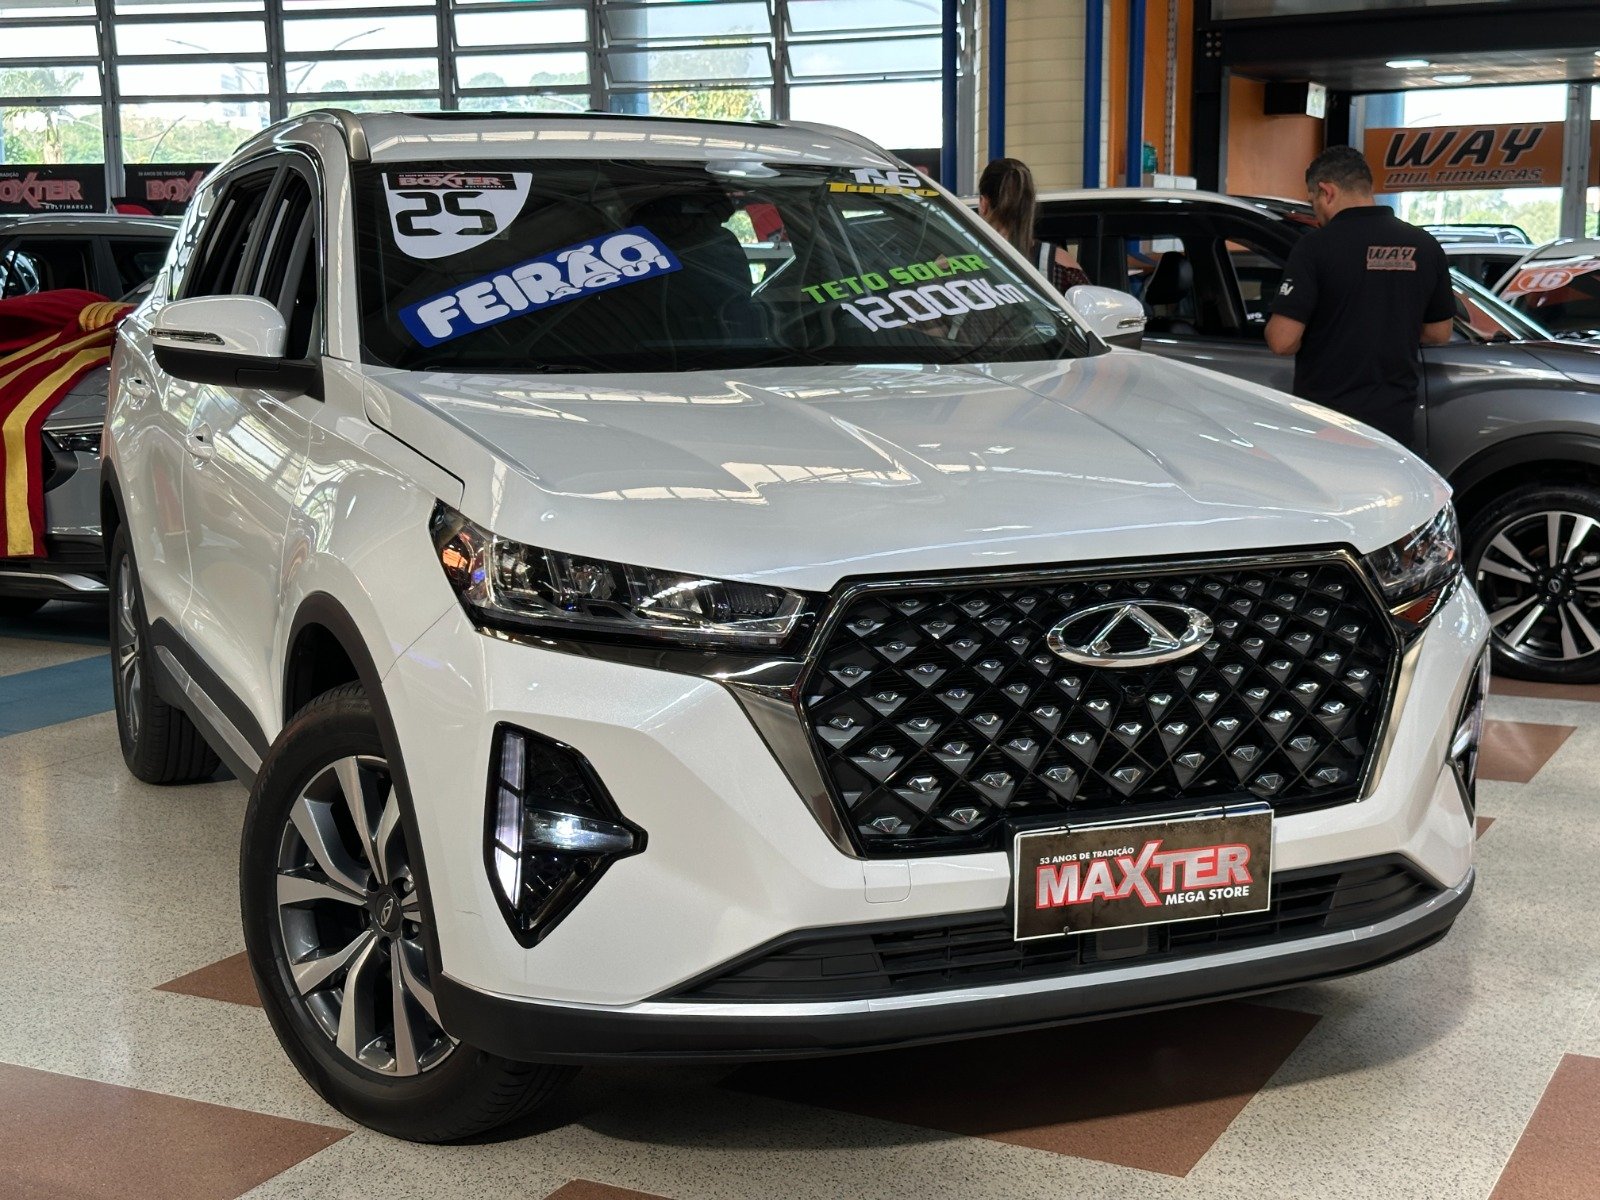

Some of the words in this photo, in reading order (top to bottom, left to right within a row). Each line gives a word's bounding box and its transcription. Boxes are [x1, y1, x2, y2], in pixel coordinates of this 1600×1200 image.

[1384, 125, 1546, 168] WAY
[0, 172, 83, 208] OXTER
[146, 170, 204, 202] BOX
[398, 173, 505, 188] BOXTER
[1384, 167, 1543, 185] MULTIMARCAS
[395, 191, 498, 237] 25
[1368, 246, 1415, 260] WAY
[416, 234, 661, 339] FEIRÃO
[801, 272, 889, 304] TETO
[888, 254, 990, 285] SOLAR
[1526, 270, 1567, 289] 16
[1039, 857, 1050, 865] 53
[1052, 854, 1078, 864] ANOS
[1079, 851, 1091, 860] DE
[1092, 847, 1135, 859] TRADIÇÃO
[1036, 839, 1253, 909] MAXTER
[1165, 891, 1206, 906] MEGA
[1208, 885, 1250, 900] STORE
